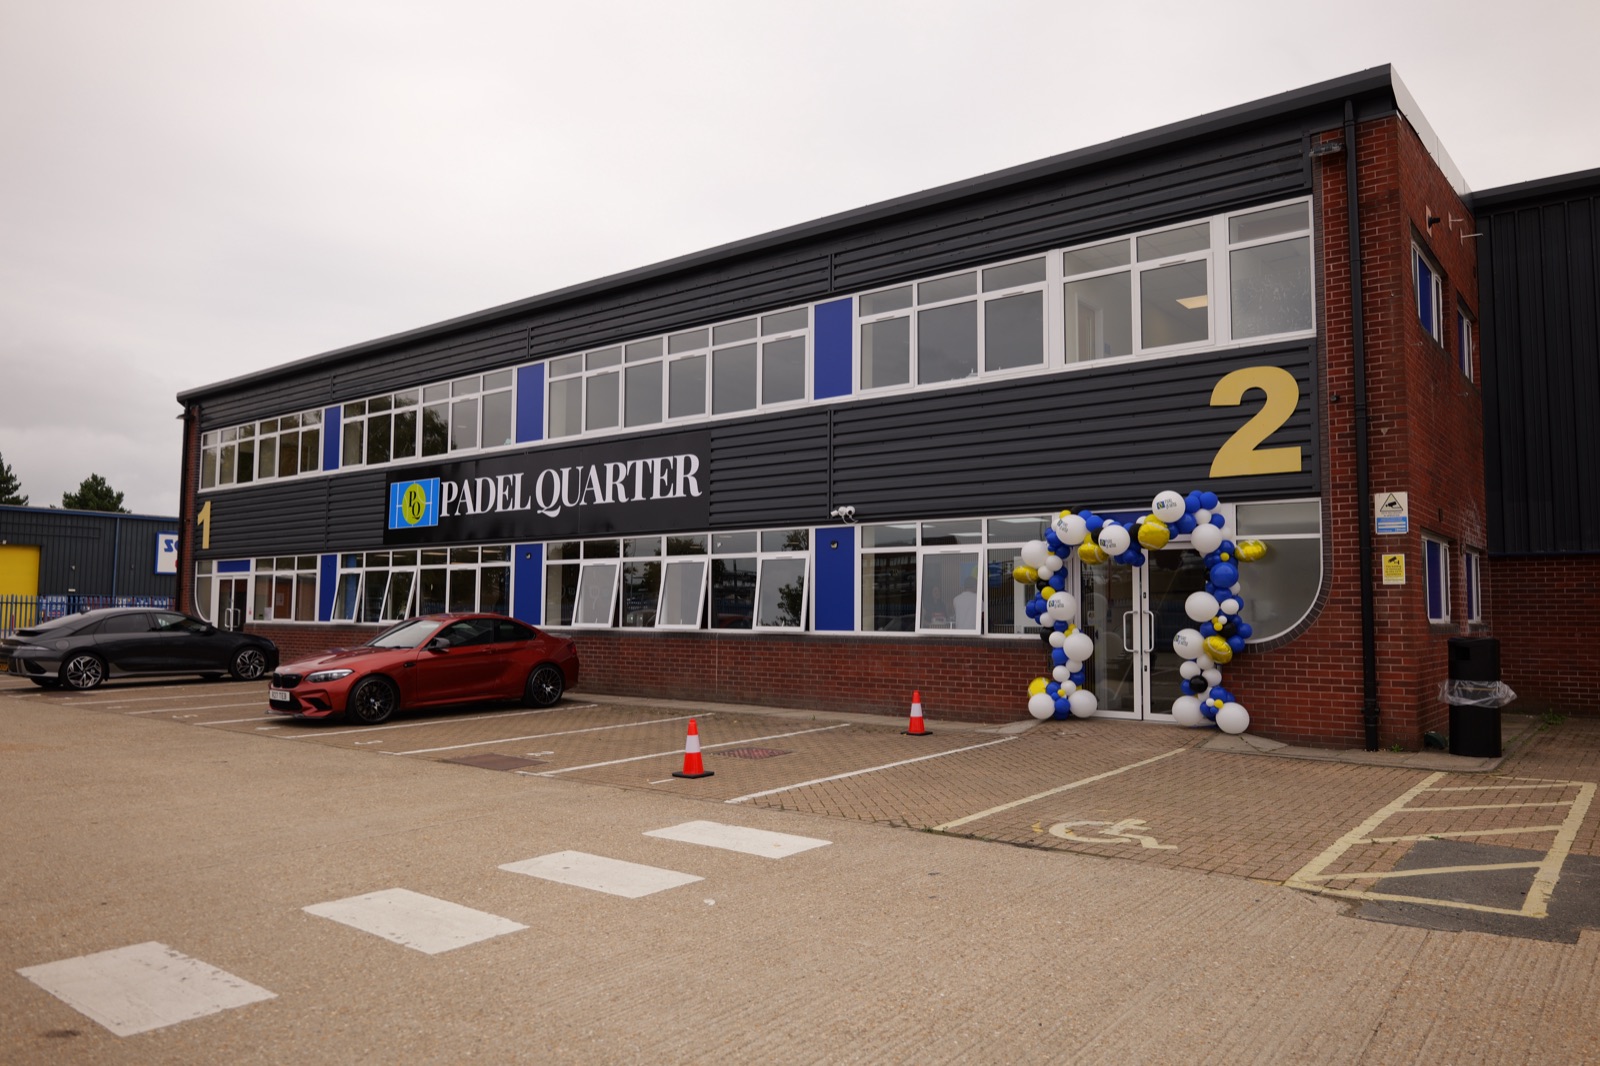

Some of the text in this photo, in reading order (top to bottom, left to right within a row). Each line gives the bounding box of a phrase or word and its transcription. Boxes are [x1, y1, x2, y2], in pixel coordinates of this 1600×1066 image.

[1209, 366, 1302, 478] 2
[440, 453, 702, 518] PADEL QUARTER
[197, 500, 211, 549] 1
